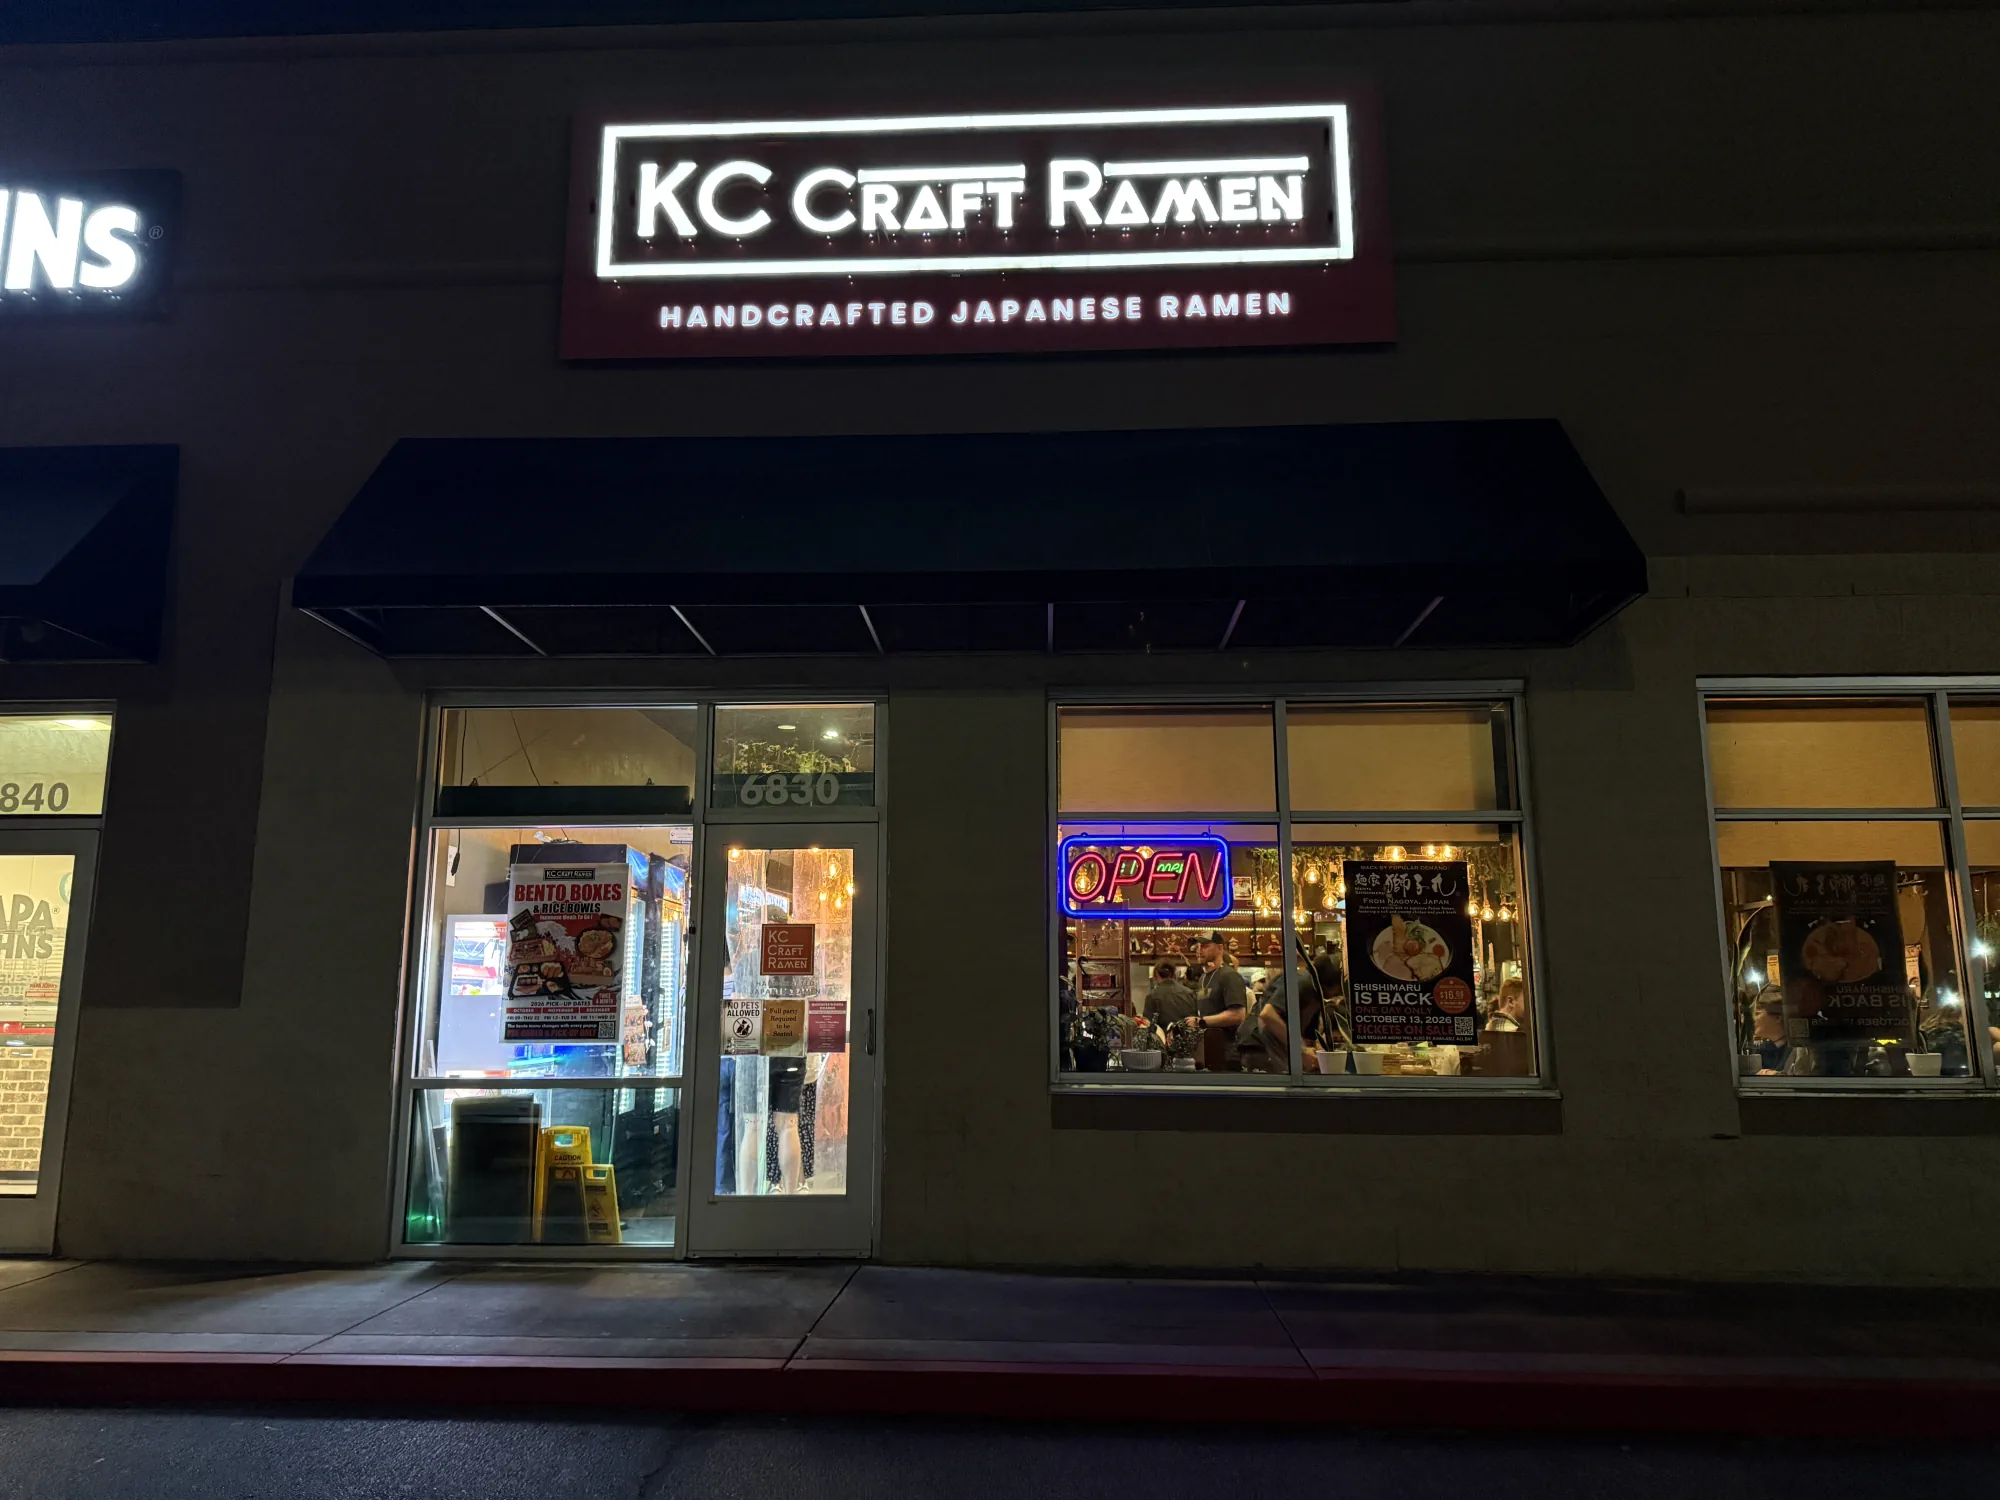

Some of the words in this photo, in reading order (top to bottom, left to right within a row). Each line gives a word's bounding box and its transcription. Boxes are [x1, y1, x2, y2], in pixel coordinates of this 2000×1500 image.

[637, 161, 771, 236] KC
[793, 168, 1025, 232] CRAFT
[1049, 159, 1306, 227] RAMEN
[660, 303, 934, 328] HANDCRAFTED
[951, 296, 1141, 323] JAPANESE
[1160, 292, 1290, 318] RAMEN
[740, 774, 840, 805] 6830
[0, 782, 69, 813] 840
[1068, 851, 1223, 902] OPEN
[515, 884, 566, 901] BENTO
[570, 883, 622, 901] BOXES
[0, 894, 53, 930] PA
[533, 905, 540, 914] &
[542, 904, 566, 914] RICE
[567, 903, 601, 913] BOWLS
[768, 931, 788, 943] KC
[768, 944, 803, 956] CRAFT
[768, 957, 808, 969] RAMEN
[1354, 983, 1421, 991] SHISHIMARU
[1355, 992, 1372, 1004] IS
[1378, 992, 1432, 1005] BACK
[1355, 1006, 1378, 1014] ONE
[1381, 1006, 1401, 1014] DAY
[1356, 1015, 1406, 1023] OCTOBER
[1409, 1016, 1423, 1024] 13,
[1425, 1016, 1452, 1024] 2026
[1356, 1024, 1401, 1034] TICKETS
[1404, 1025, 1422, 1035] ON
[1426, 1025, 1454, 1035] SALE
